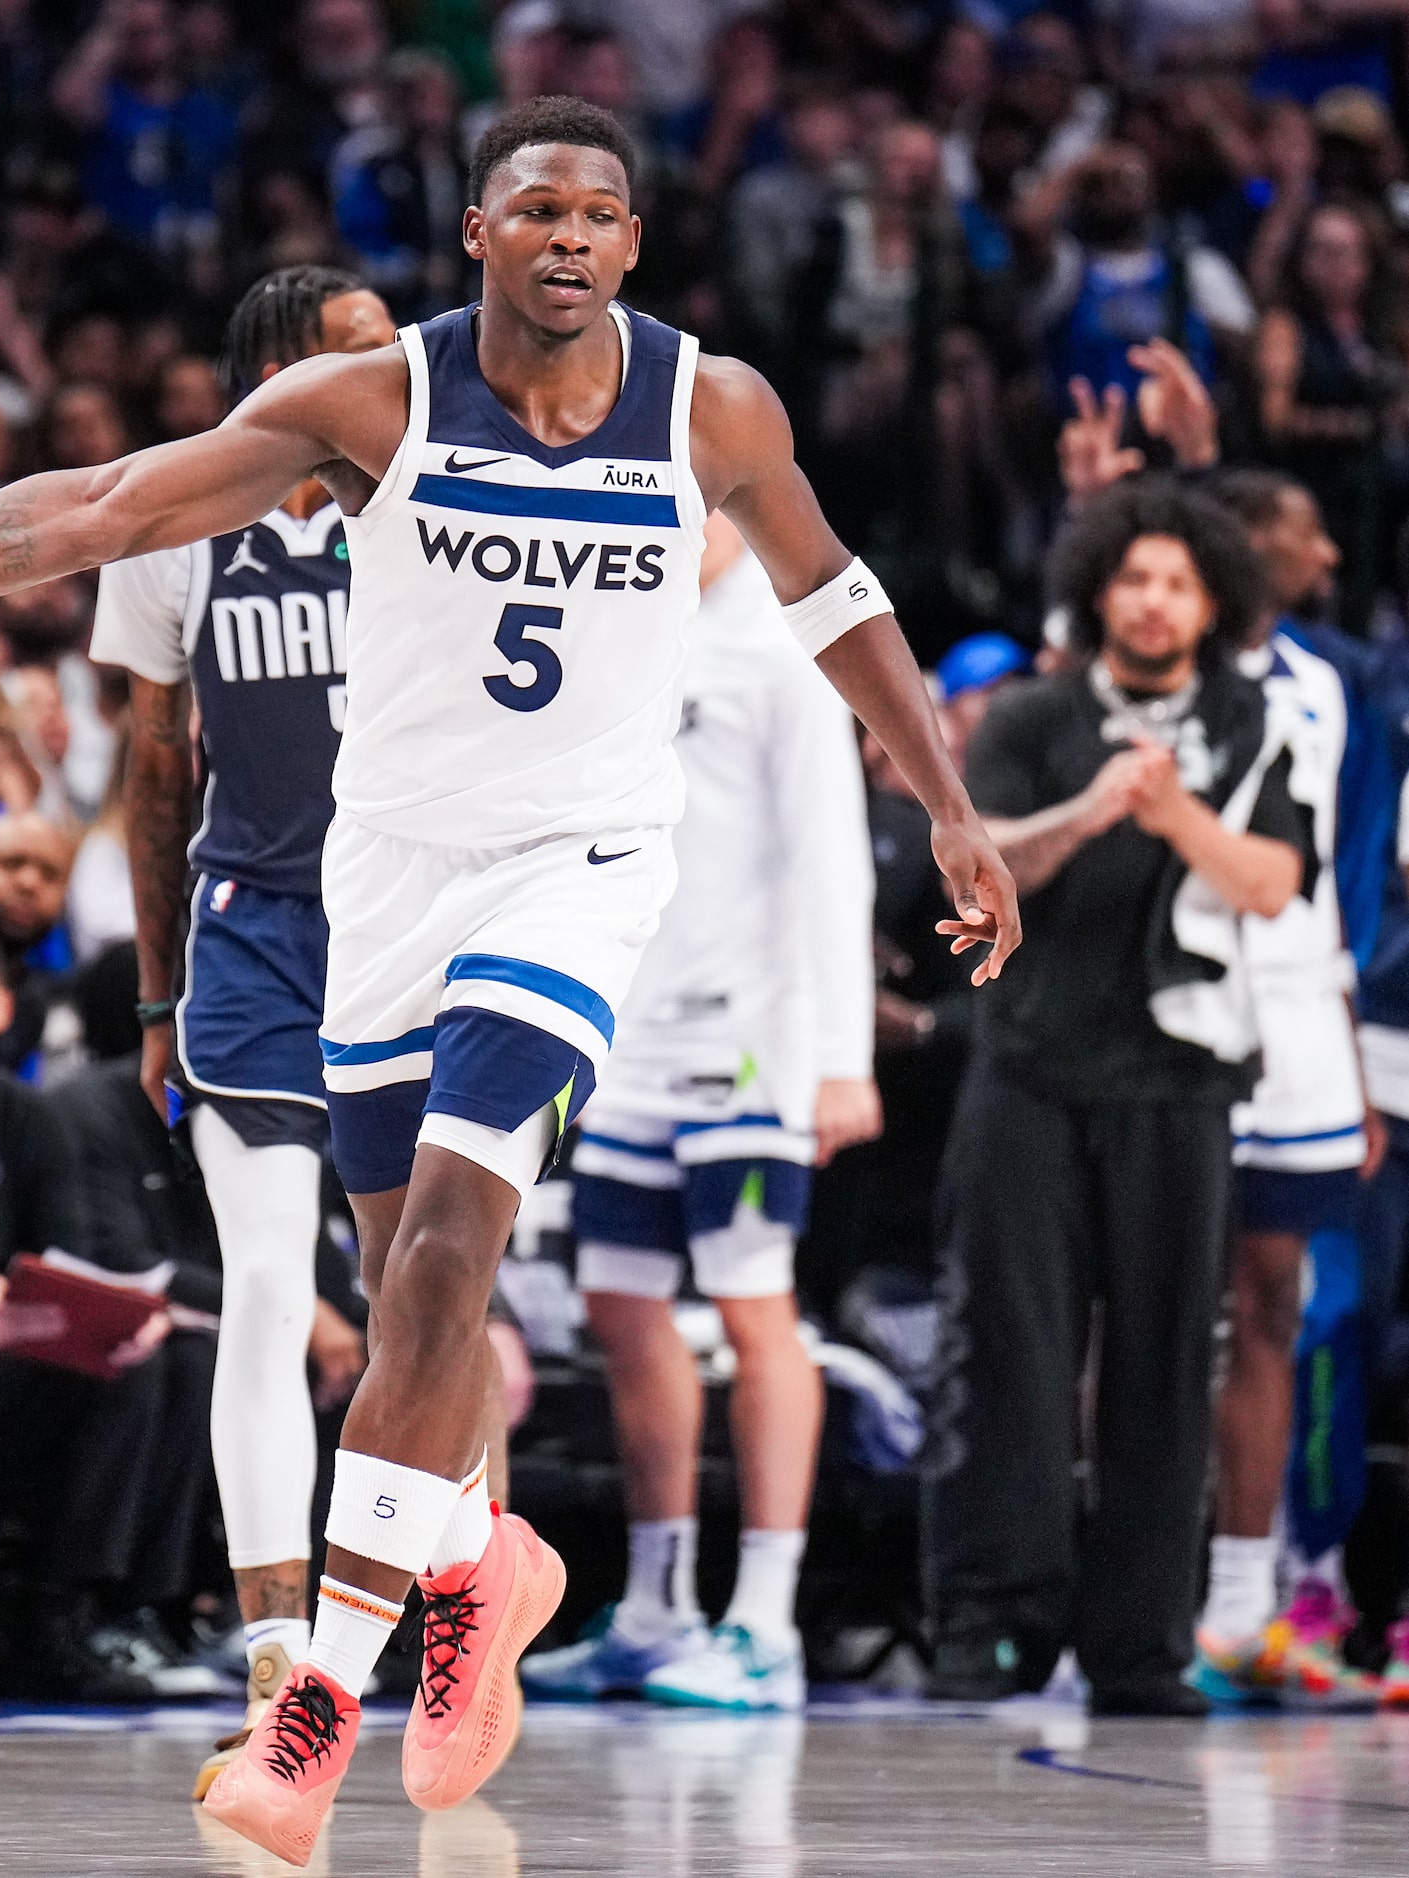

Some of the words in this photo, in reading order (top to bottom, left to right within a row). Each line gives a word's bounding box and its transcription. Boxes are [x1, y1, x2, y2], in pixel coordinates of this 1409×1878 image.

[415, 516, 667, 592] WOLVES
[848, 580, 869, 603] 5
[481, 602, 565, 713] 5
[373, 1495, 398, 1519] 5
